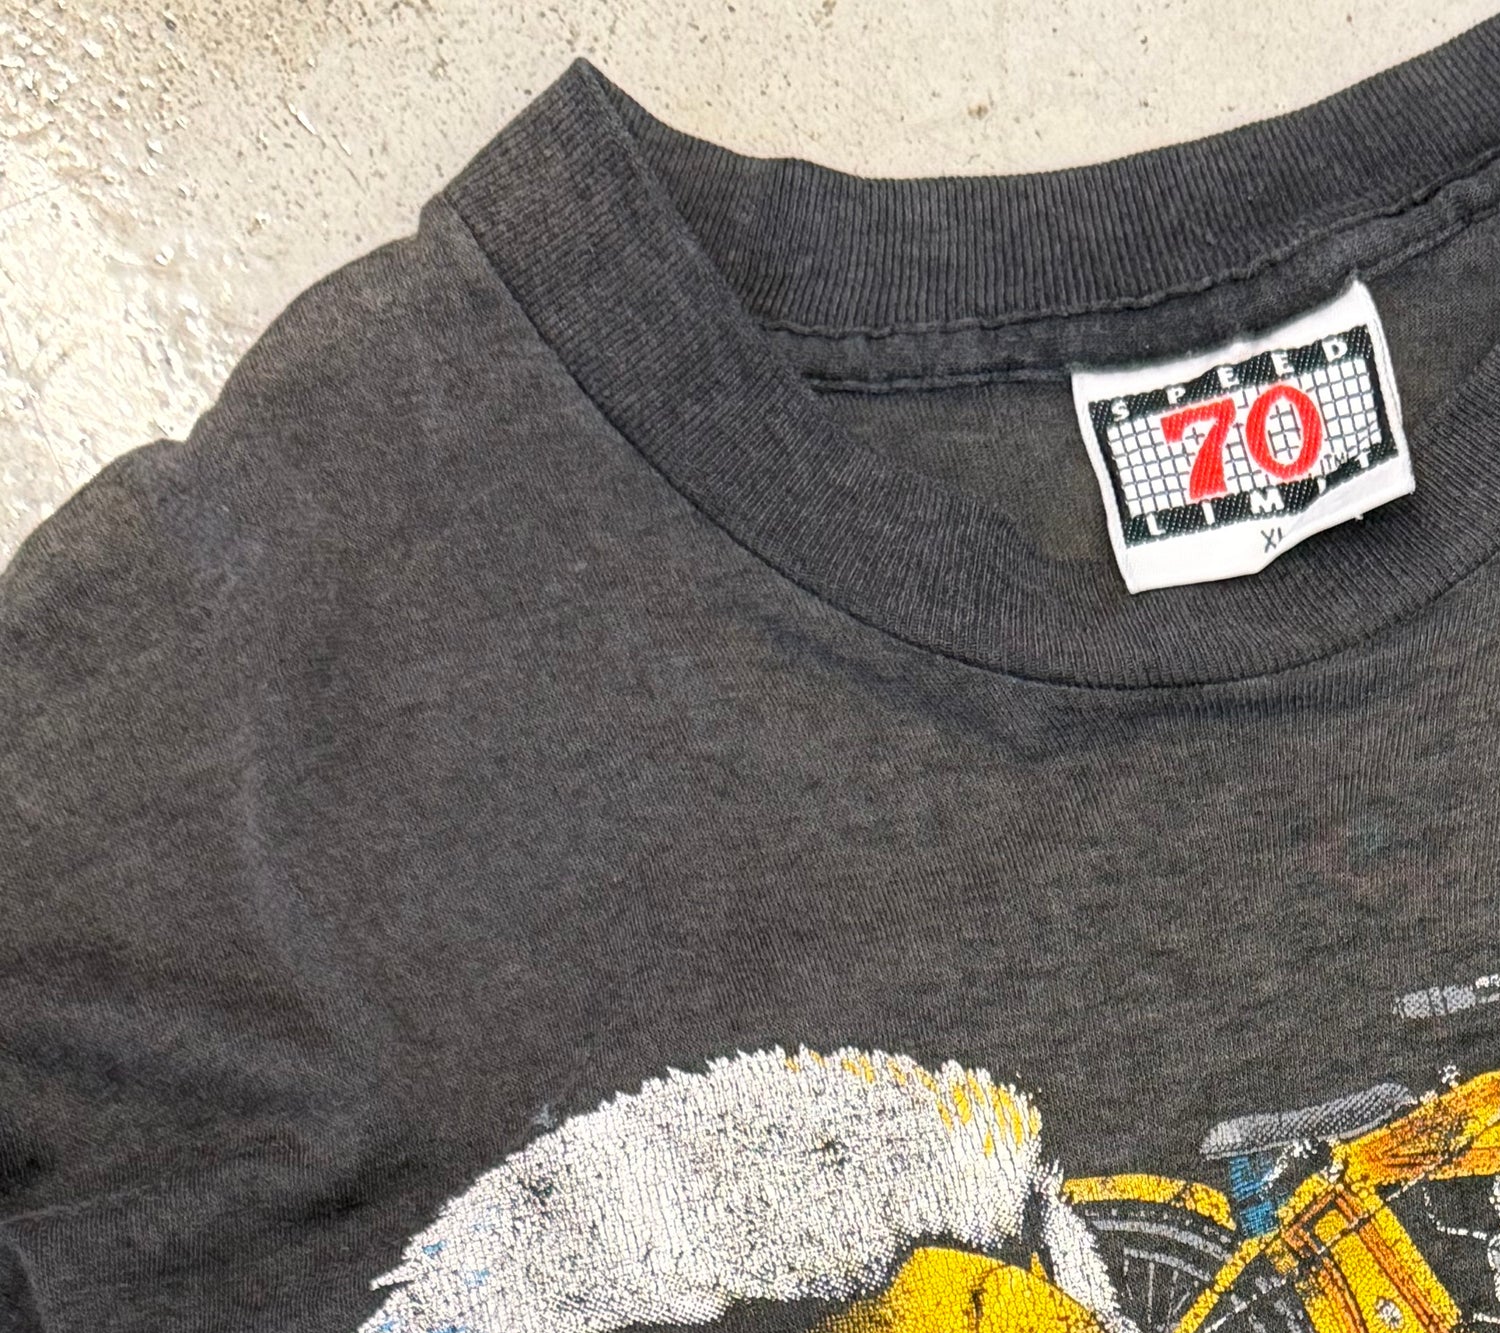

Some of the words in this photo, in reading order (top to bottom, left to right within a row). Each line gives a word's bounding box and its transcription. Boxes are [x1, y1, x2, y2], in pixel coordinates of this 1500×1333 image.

[1111, 339, 1349, 422] SPEED
[1160, 384, 1323, 500] 70
[1147, 450, 1372, 536] LIMIT
